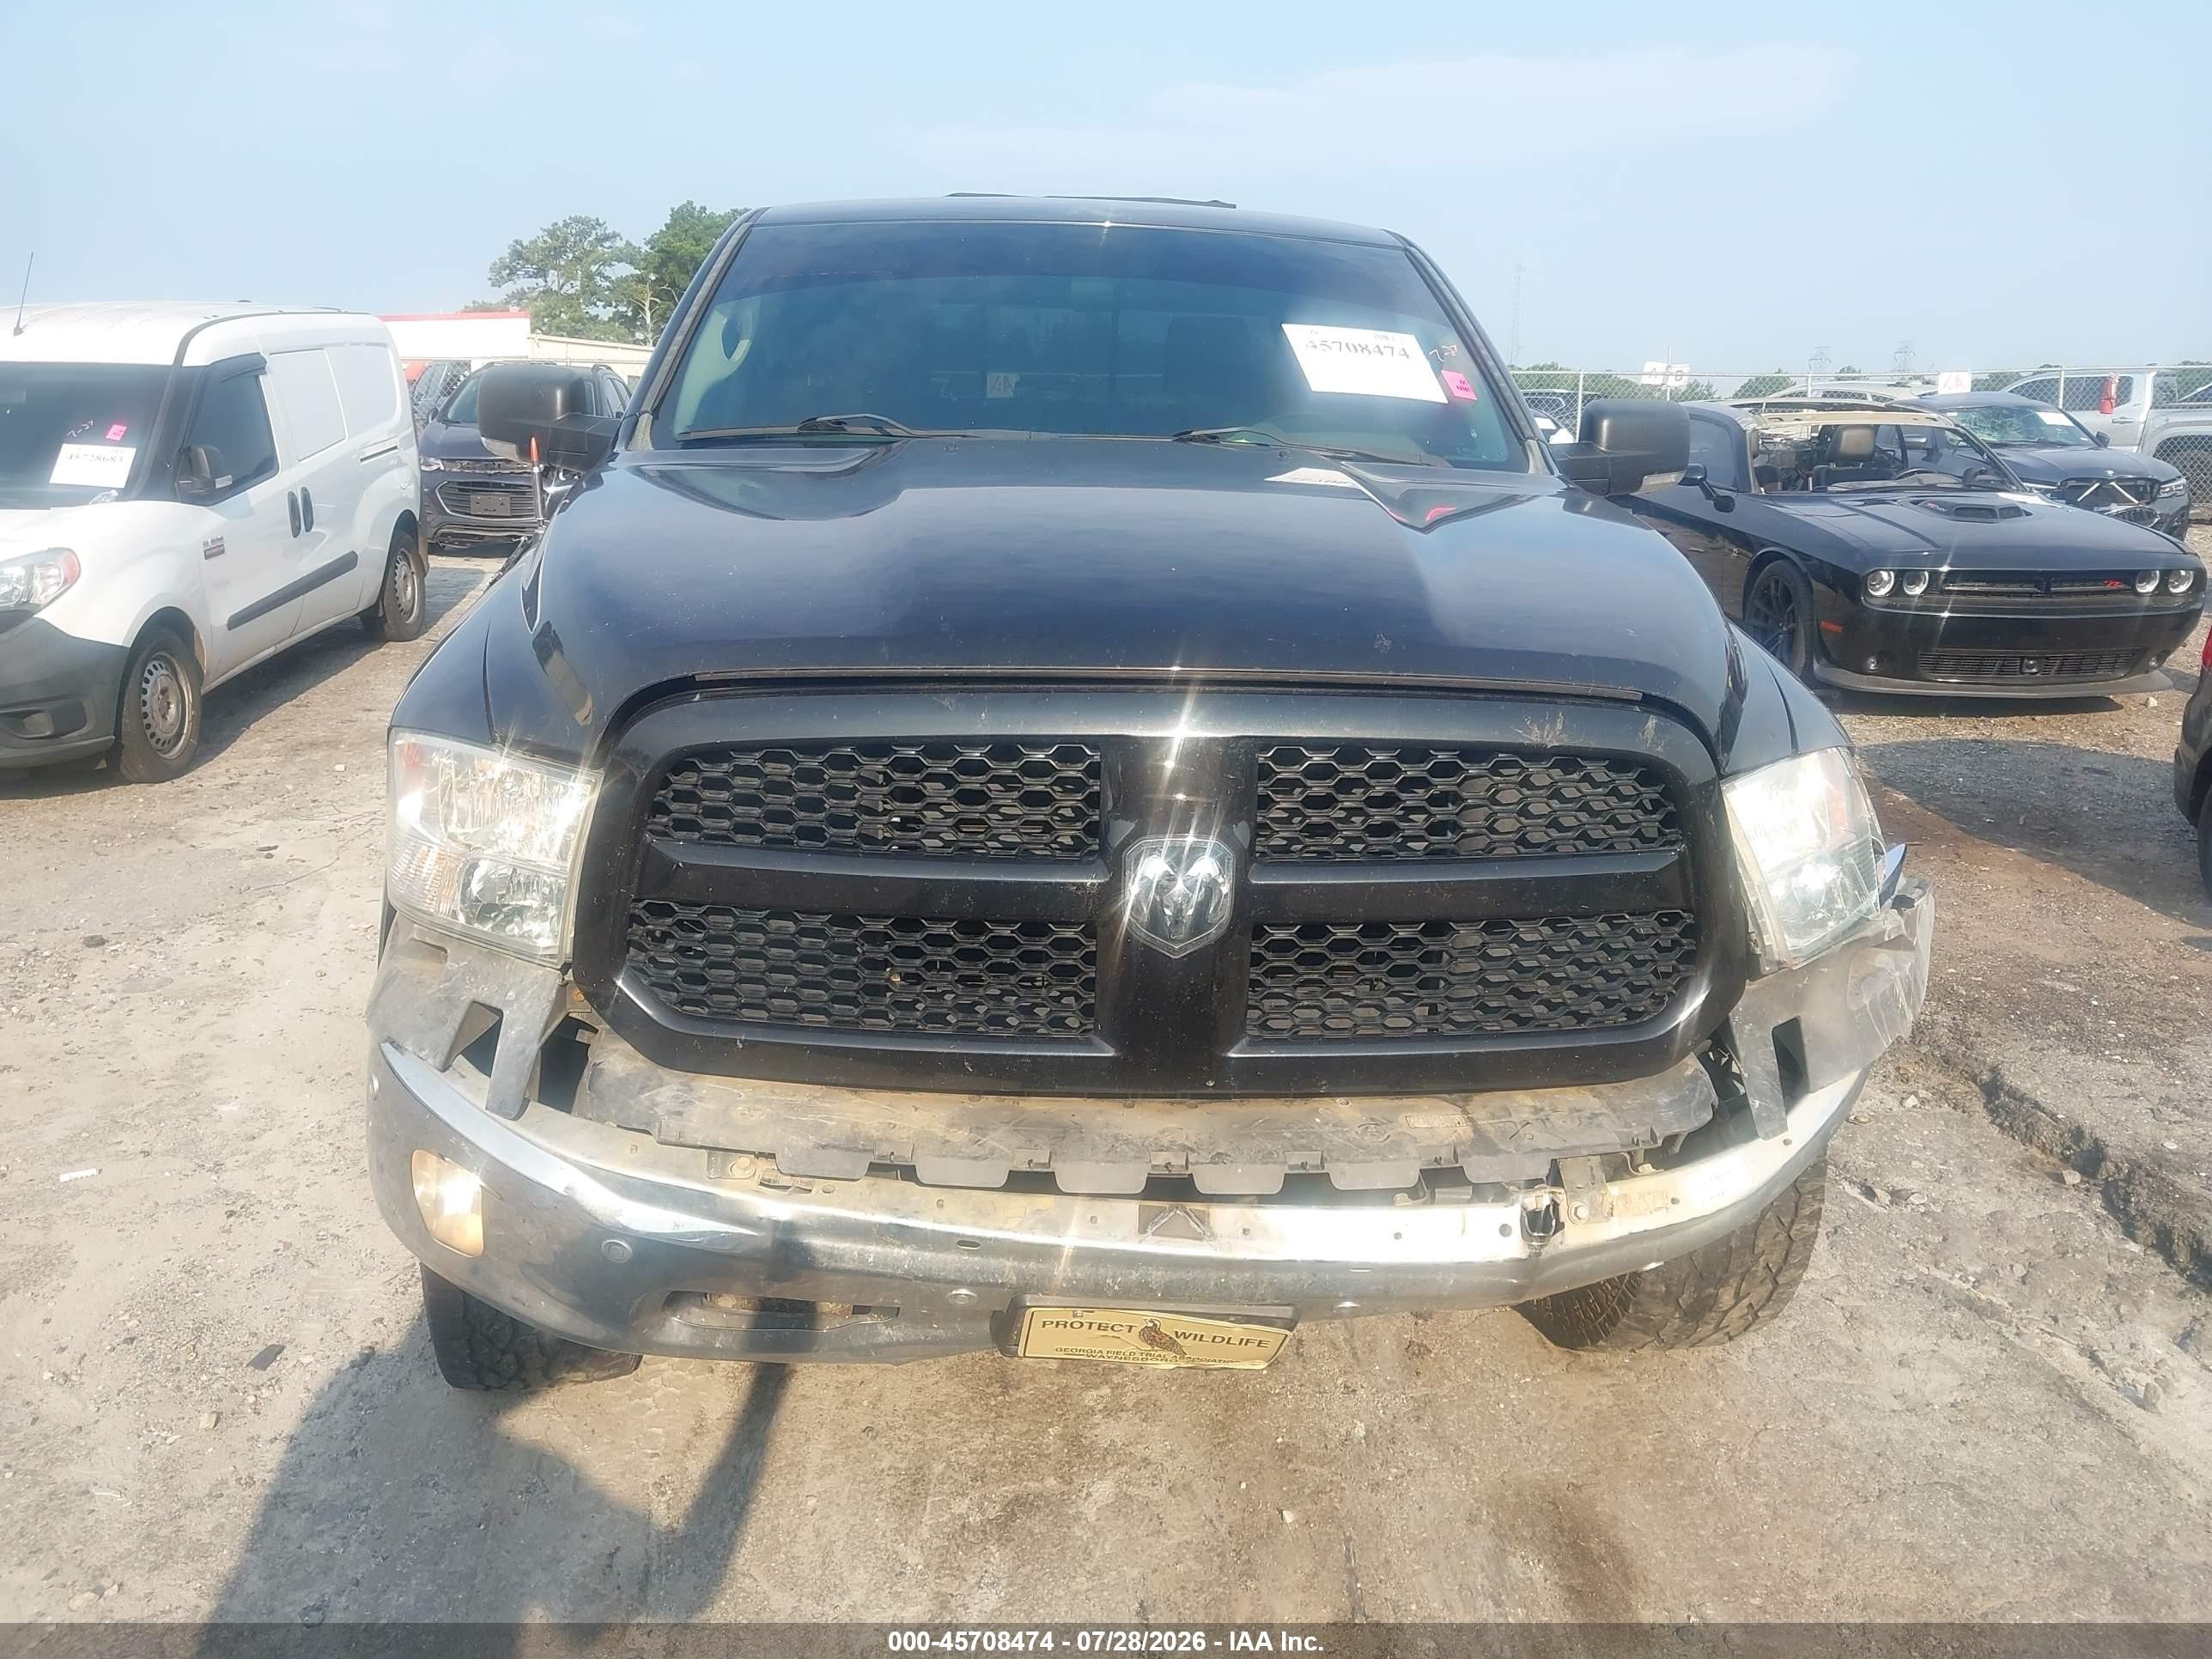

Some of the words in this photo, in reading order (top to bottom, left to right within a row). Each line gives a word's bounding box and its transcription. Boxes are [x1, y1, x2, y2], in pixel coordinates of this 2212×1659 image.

[1041, 1319, 1138, 1334] PROTECT
[1173, 1330, 1273, 1348] WILDLIFE
[1054, 1346, 1103, 1354] GEORGIA
[1141, 1351, 1170, 1359] TRIAL
